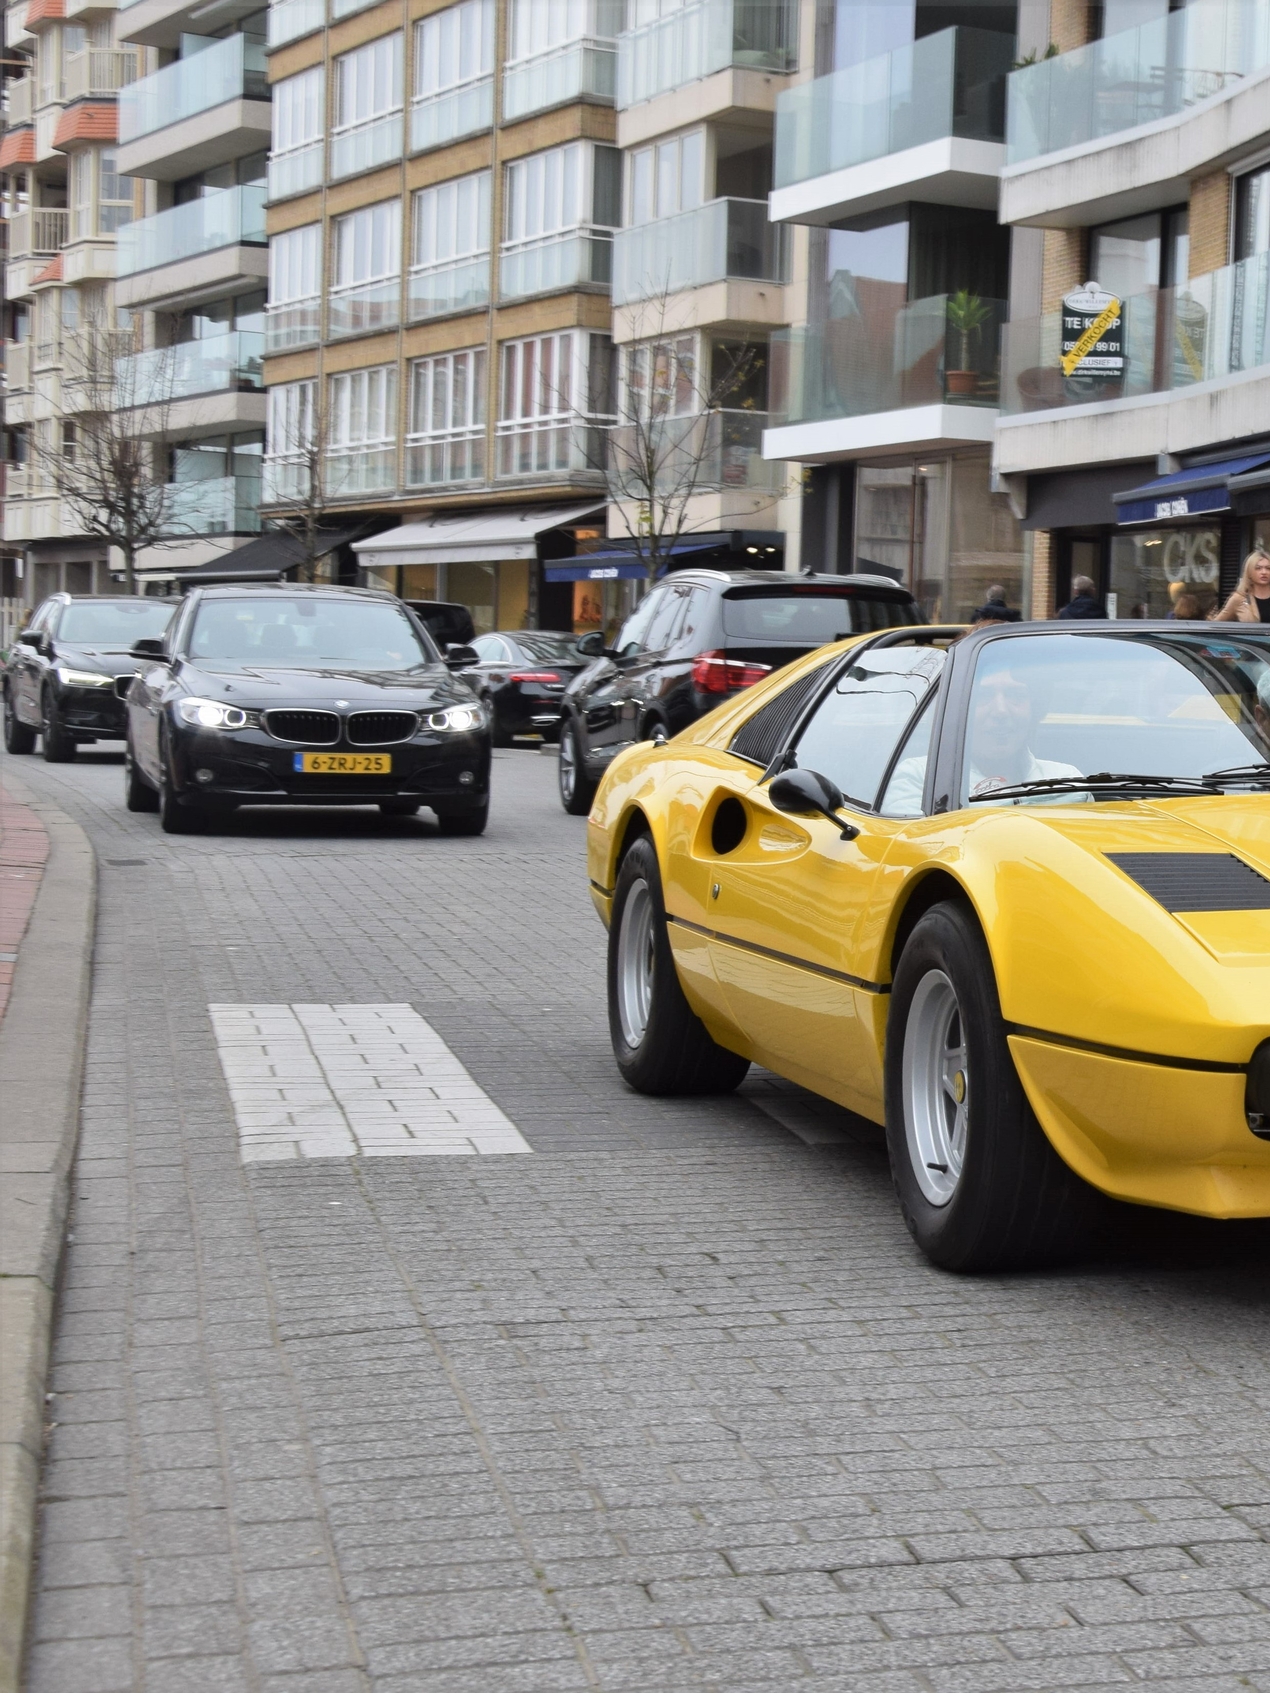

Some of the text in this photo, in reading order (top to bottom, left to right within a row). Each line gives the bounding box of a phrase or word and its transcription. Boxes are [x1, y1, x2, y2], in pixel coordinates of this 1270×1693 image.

[1064, 317, 1121, 330] TE KP
[1073, 309, 1117, 358] VERKOCHT
[1163, 532, 1219, 583] CKS
[311, 756, 383, 771] 6-ZRJ-25
